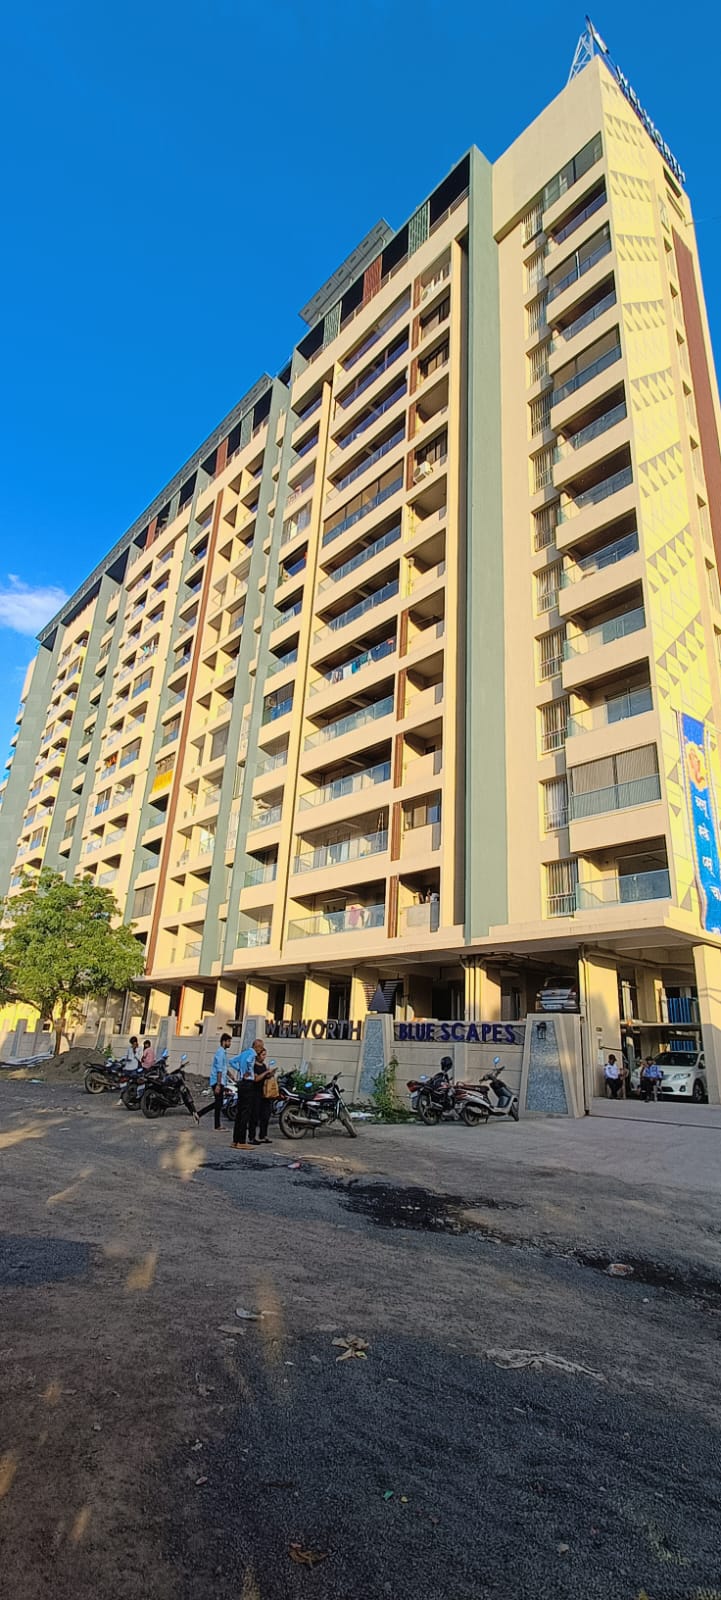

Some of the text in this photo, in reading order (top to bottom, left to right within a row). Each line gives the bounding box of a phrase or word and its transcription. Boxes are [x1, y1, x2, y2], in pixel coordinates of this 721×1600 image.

[264, 1019, 362, 1041] WELWORTH
[399, 1022, 516, 1043] BLUE SCAPES
